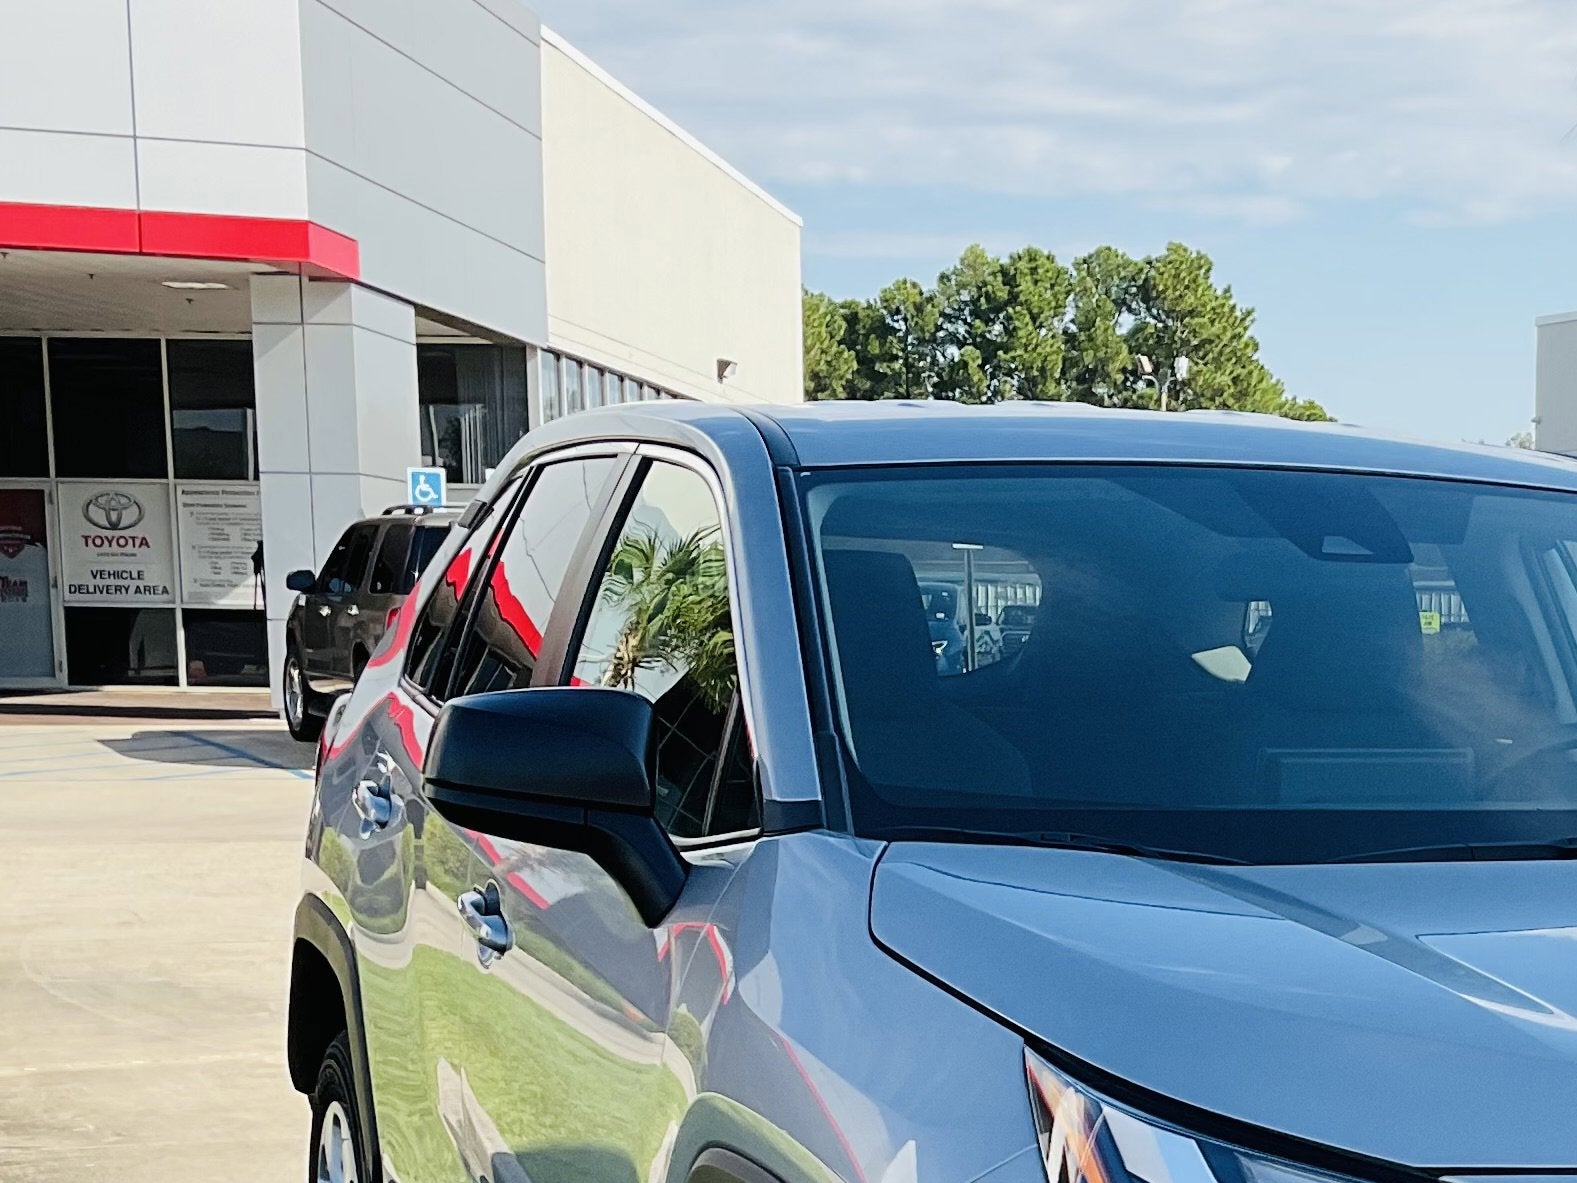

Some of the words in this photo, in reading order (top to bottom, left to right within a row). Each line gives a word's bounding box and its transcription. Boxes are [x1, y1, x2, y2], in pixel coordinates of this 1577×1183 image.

[81, 535, 150, 548] TOYOTA
[90, 569, 144, 580] VEHICLE
[68, 583, 130, 594] DELIVERY
[134, 585, 170, 595] AREA
